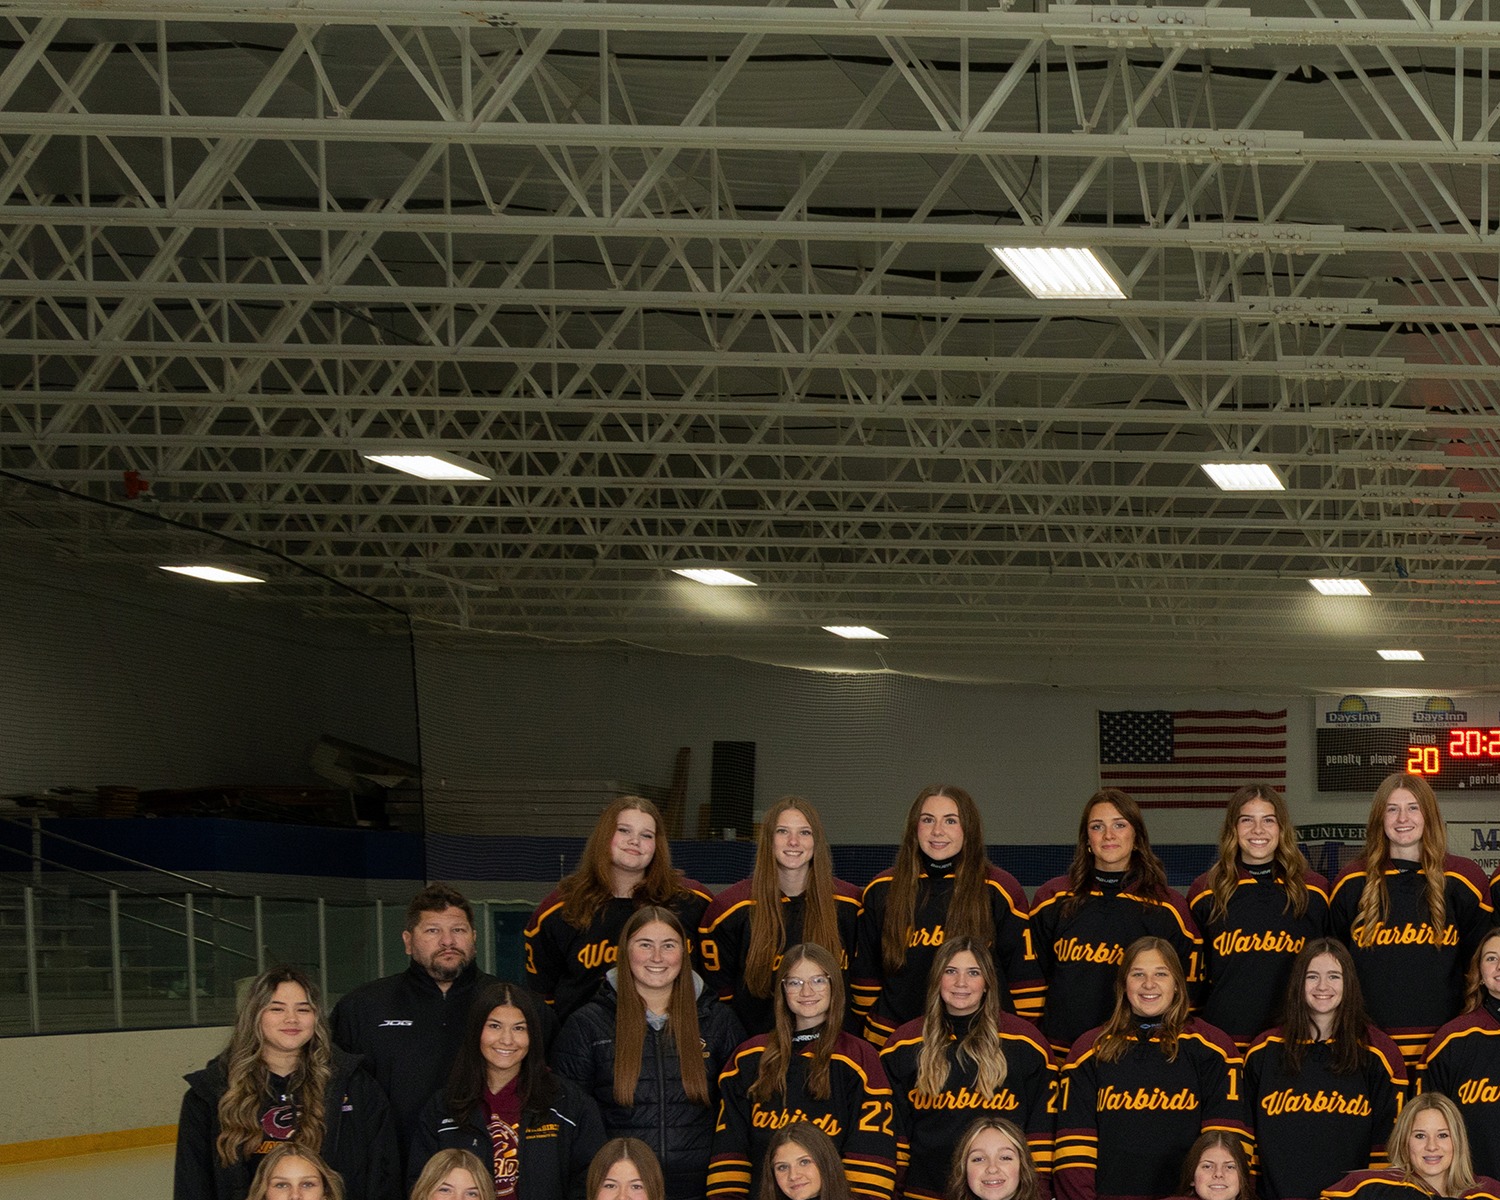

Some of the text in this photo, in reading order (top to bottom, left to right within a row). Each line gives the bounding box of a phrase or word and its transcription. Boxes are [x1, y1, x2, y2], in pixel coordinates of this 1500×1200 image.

[1329, 712, 1378, 722] Days Inn
[1416, 711, 1465, 722] Days Inn
[1409, 732, 1437, 744] Home
[1326, 754, 1397, 767] penalty player
[1407, 747, 1439, 774] 20
[1469, 773, 1500, 787] period
[1310, 827, 1366, 839] UNIVER
[700, 939, 721, 972] 9
[1053, 936, 1126, 966] Warbir
[1213, 928, 1307, 957] Warbird
[1096, 1084, 1200, 1113] Warbirds
[1261, 1088, 1372, 1117] Warbirds
[858, 1099, 895, 1137] 22
